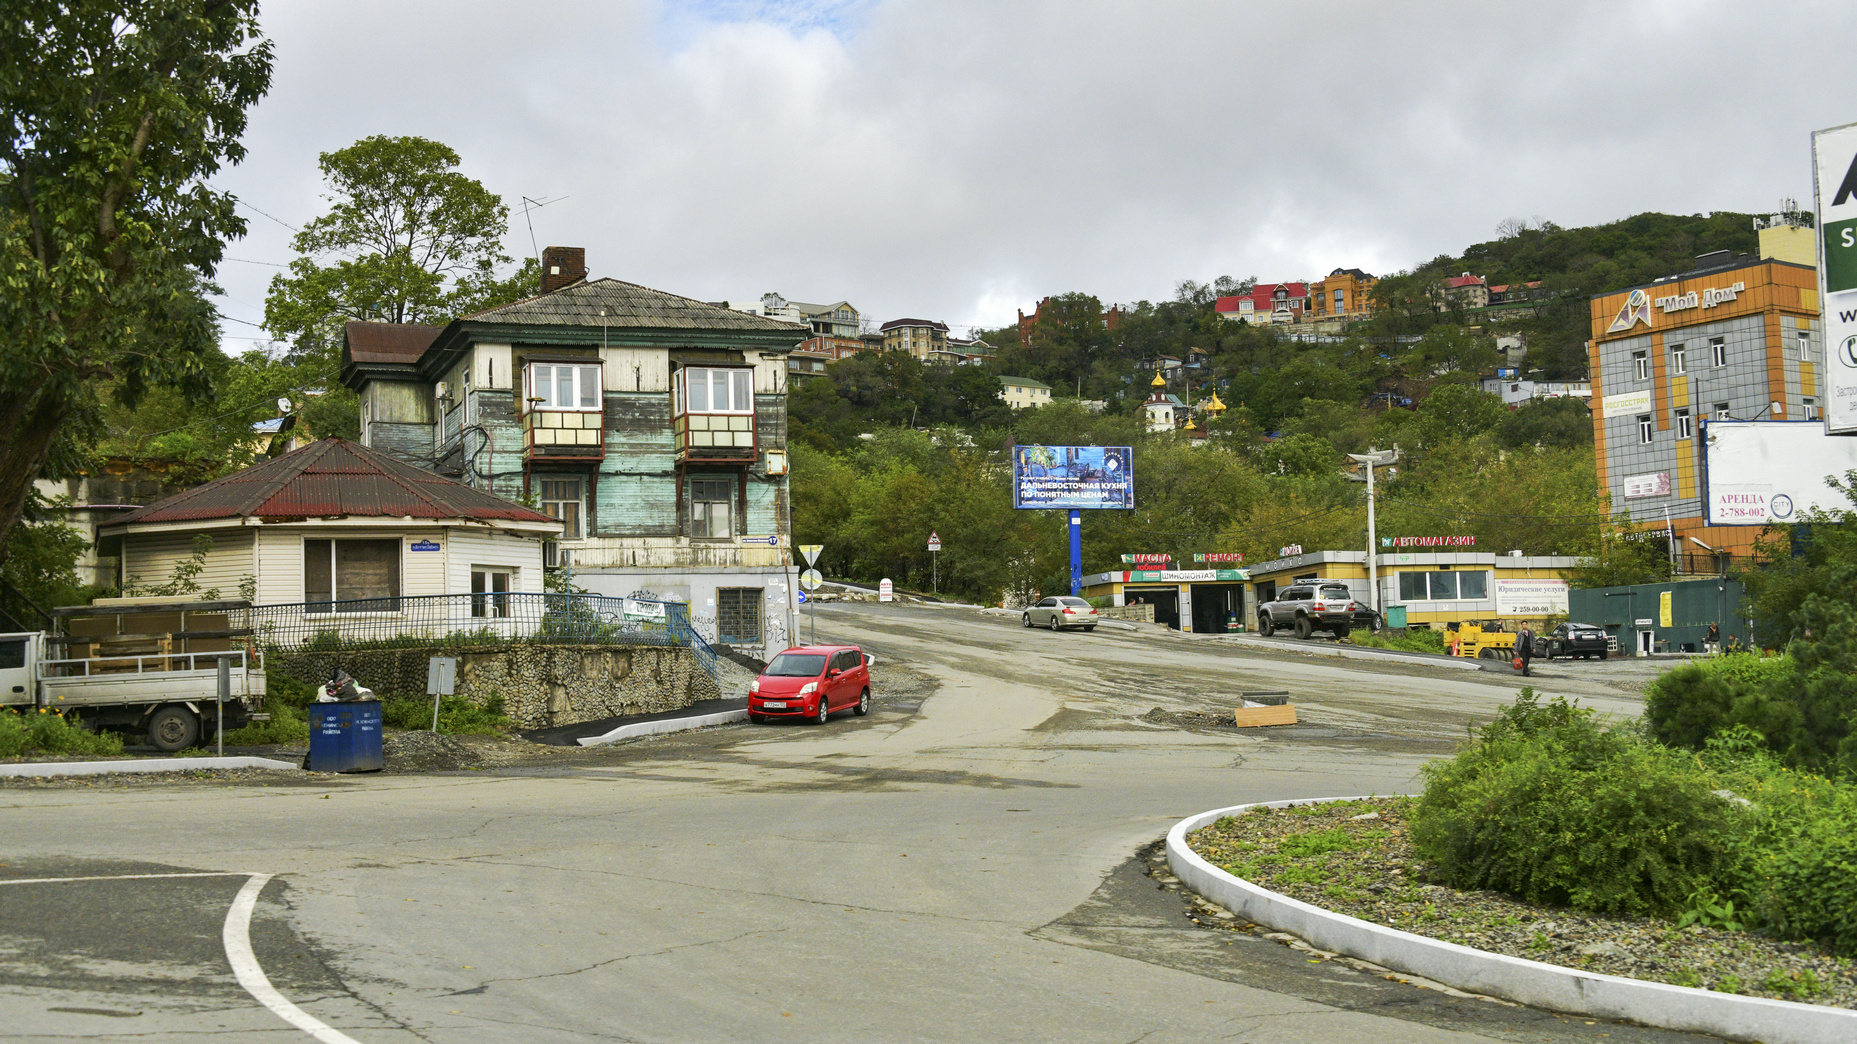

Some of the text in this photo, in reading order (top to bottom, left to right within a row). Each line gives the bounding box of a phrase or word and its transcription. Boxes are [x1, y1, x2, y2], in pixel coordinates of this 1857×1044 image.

[1605, 397, 1649, 409] РОСГОССТРАХ
[1081, 491, 1108, 499] ЦЕНАМ
[1719, 494, 1765, 504] АРЕНДА
[1719, 508, 1765, 517] 2-788-002
[1393, 536, 1476, 546] АВТОМАГАЗИН
[1134, 553, 1171, 563] МАСЛА
[1204, 553, 1245, 562] РЕМОНТ
[1161, 571, 1216, 580] ШИНОМОНТАЖ
[1498, 585, 1543, 594] Юридические
